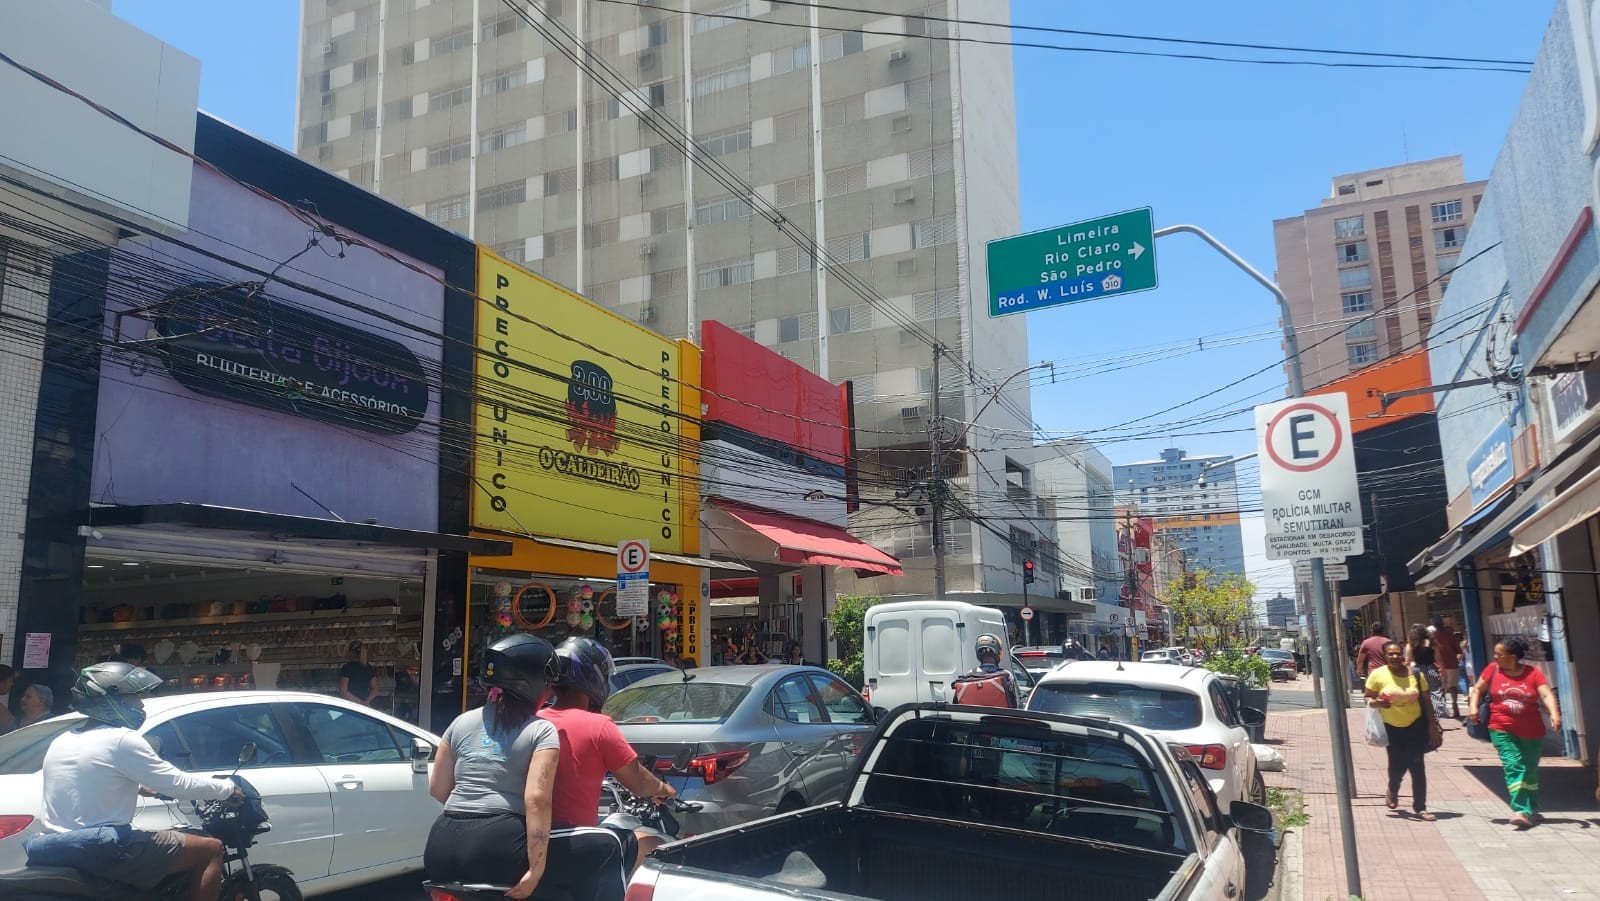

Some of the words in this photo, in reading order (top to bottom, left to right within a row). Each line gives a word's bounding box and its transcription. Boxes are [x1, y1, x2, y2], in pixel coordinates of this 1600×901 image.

[1058, 223, 1119, 246] Limeira
[1045, 252, 1069, 265] Rio
[1078, 242, 1121, 258] Claro
[1040, 270, 1067, 283] São
[1076, 259, 1122, 277] Pedro
[998, 293, 1029, 309] Rod.
[1037, 288, 1052, 301] W.
[1060, 280, 1094, 297] Luís
[1104, 280, 1119, 290] 310
[572, 365, 612, 405] 3,00
[1289, 413, 1319, 460] E
[661, 451, 672, 540] ÚNICO
[1298, 488, 1321, 501] GCM
[1272, 504, 1310, 519] POLÍCIA
[1312, 501, 1353, 515] MILITAR
[1269, 534, 1305, 543] ESTACIONAR
[1319, 531, 1356, 539] DESACORDO
[1283, 518, 1344, 534] SEMUTTRAN
[628, 549, 638, 565] E
[1283, 549, 1311, 557] PONTOS
[688, 606, 696, 654] PREÇO
